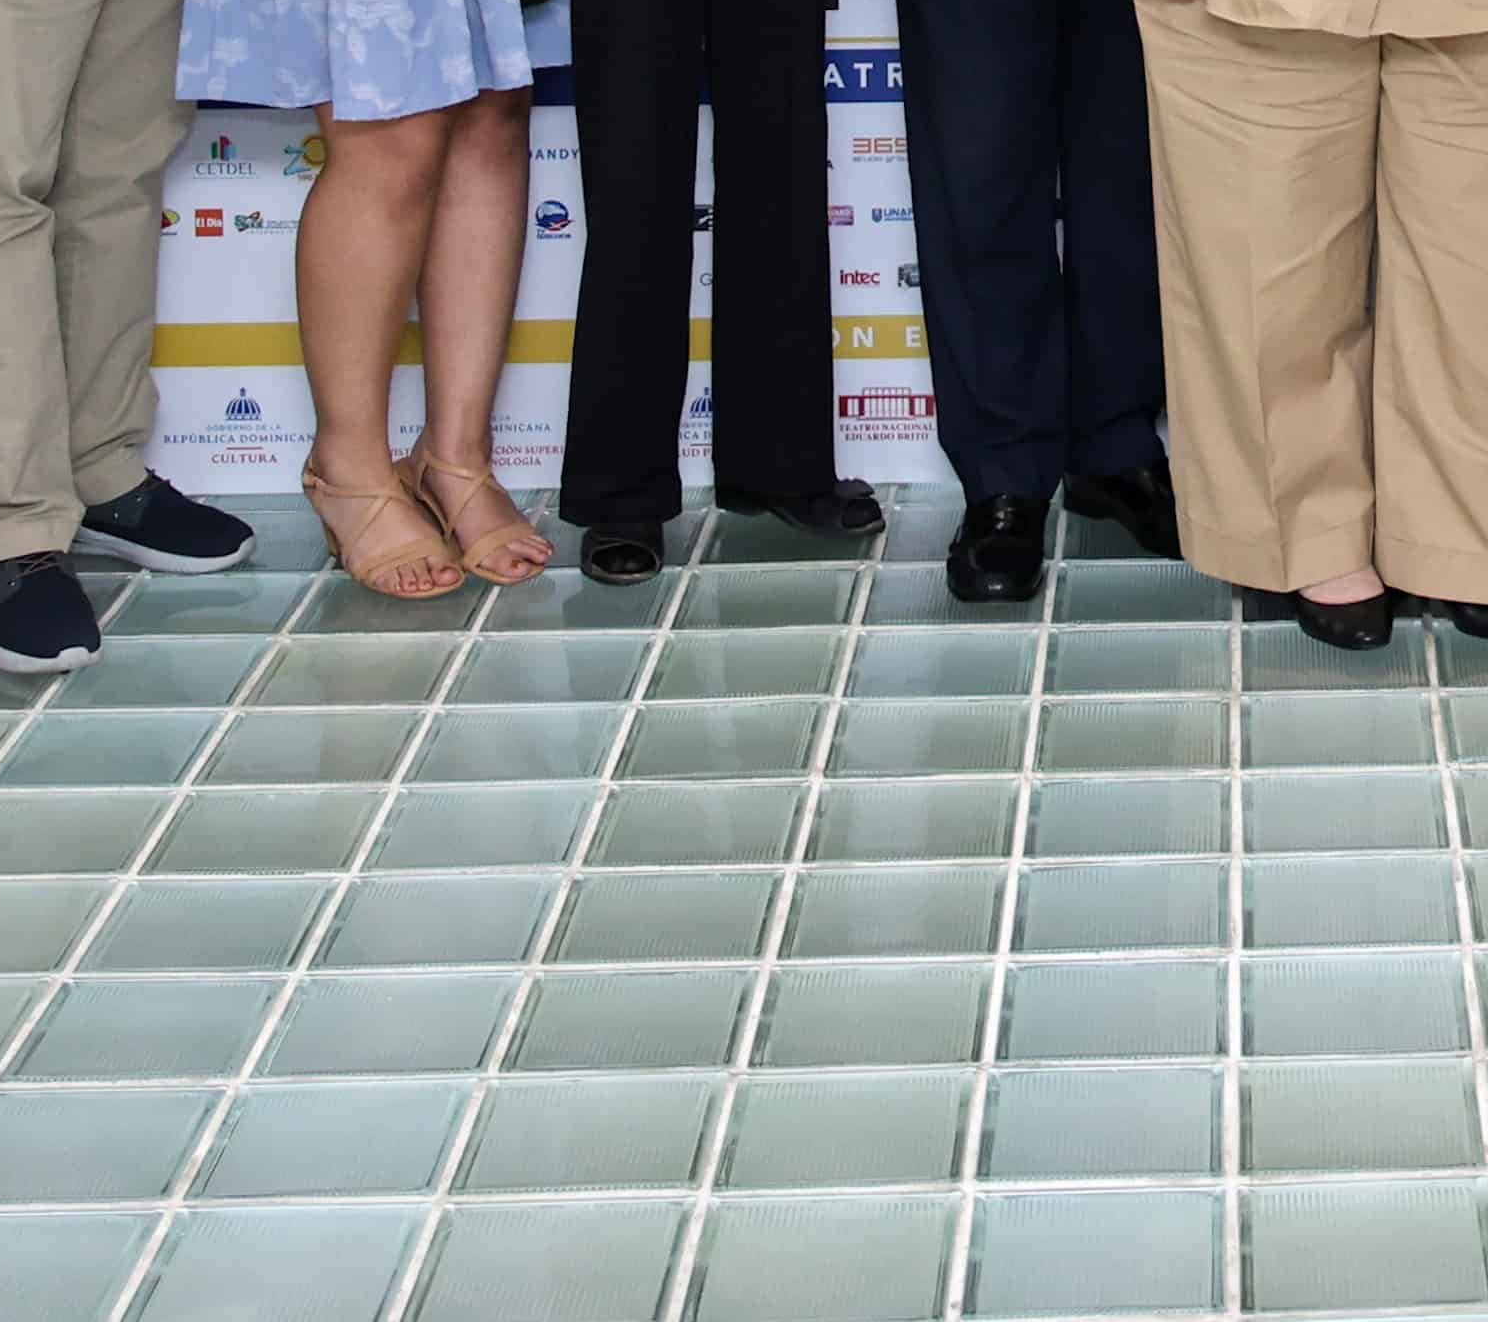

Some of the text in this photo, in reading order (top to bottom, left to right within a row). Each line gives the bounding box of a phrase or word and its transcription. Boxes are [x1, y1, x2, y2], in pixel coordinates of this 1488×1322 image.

[840, 269, 881, 285] intec
[493, 424, 552, 434] MINICANA
[164, 432, 316, 444] REPÚBLICA DOMINICAN
[525, 445, 564, 455] SUPERI
[211, 453, 279, 464] CULTURA
